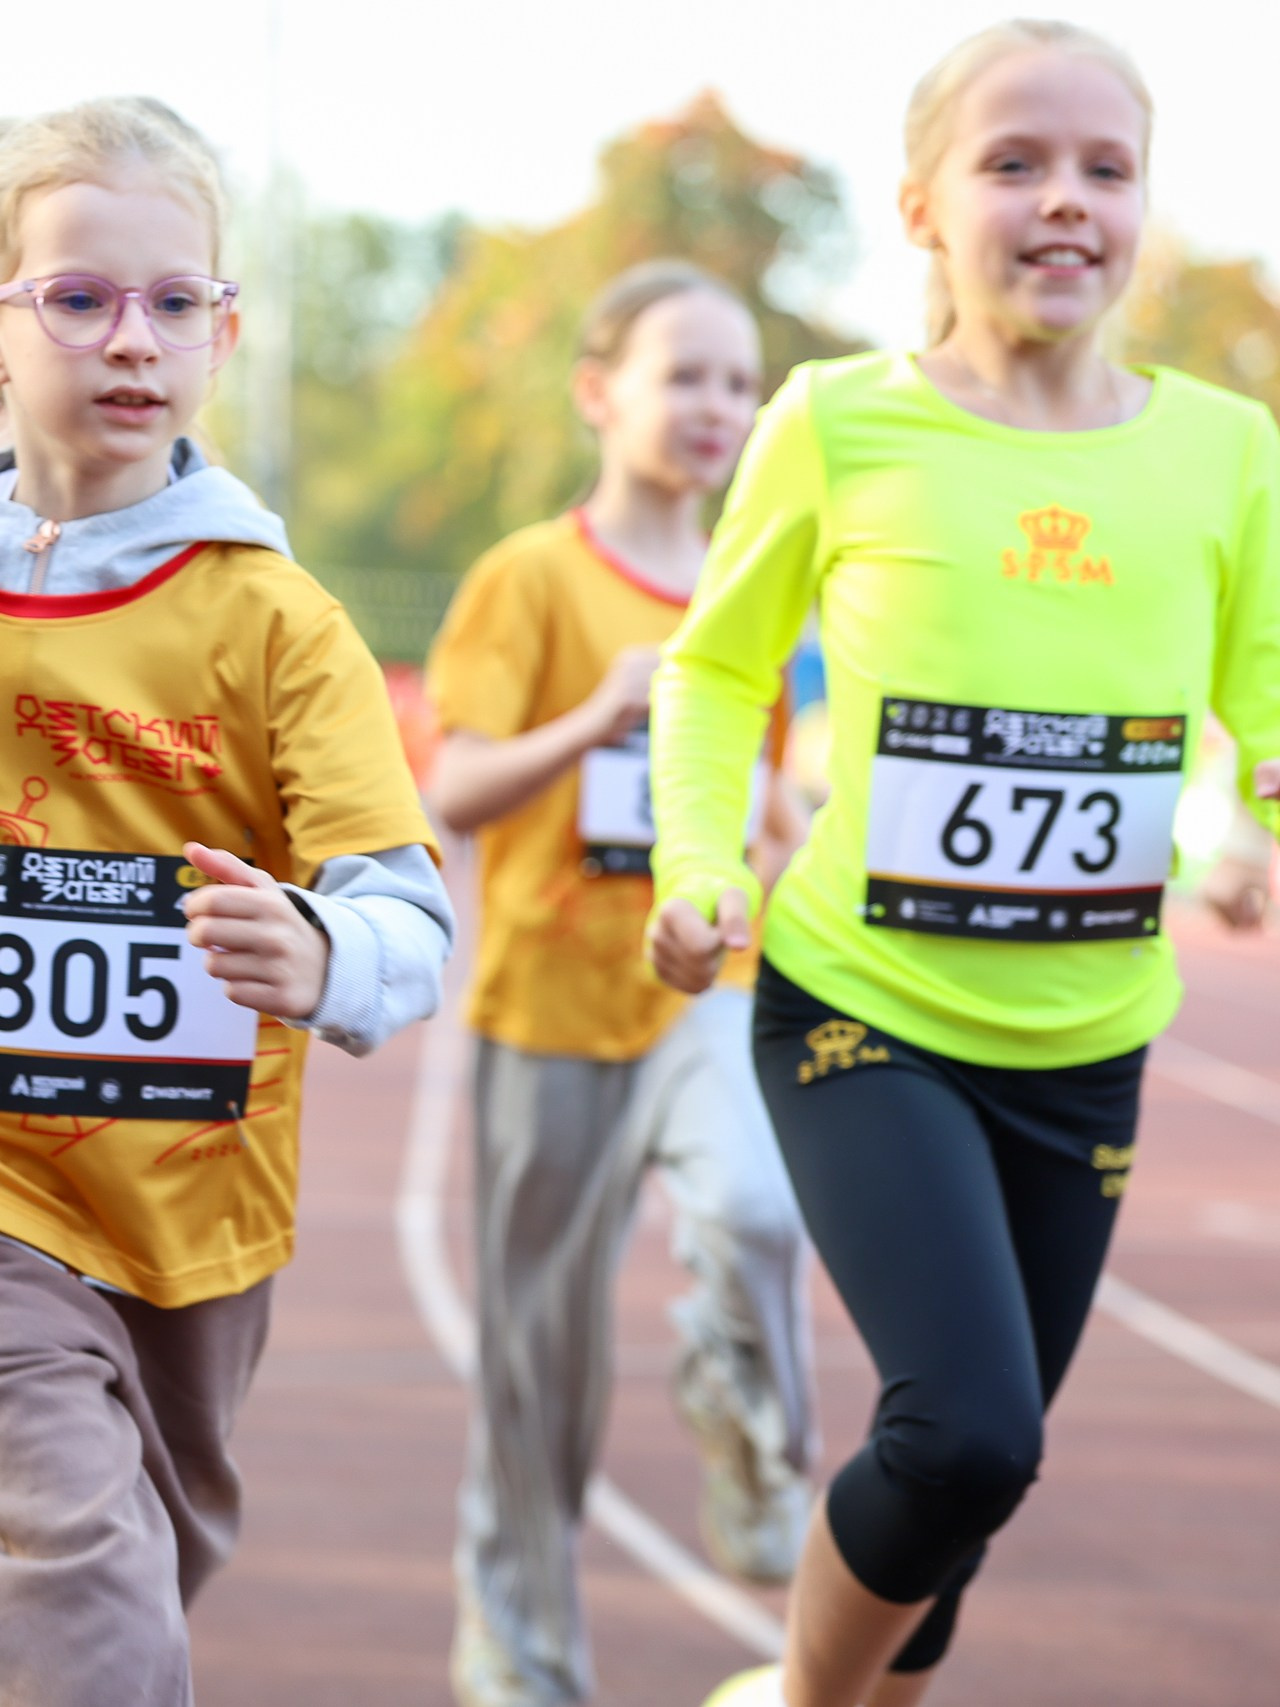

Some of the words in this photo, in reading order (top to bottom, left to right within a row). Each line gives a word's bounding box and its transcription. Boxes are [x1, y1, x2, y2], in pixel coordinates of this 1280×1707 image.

[14, 694, 221, 756] ДЕТСКИЙ
[940, 782, 1122, 874] 673
[21, 852, 156, 885] ДЕТСКИЙ
[41, 878, 137, 905] ЗАБЕГ
